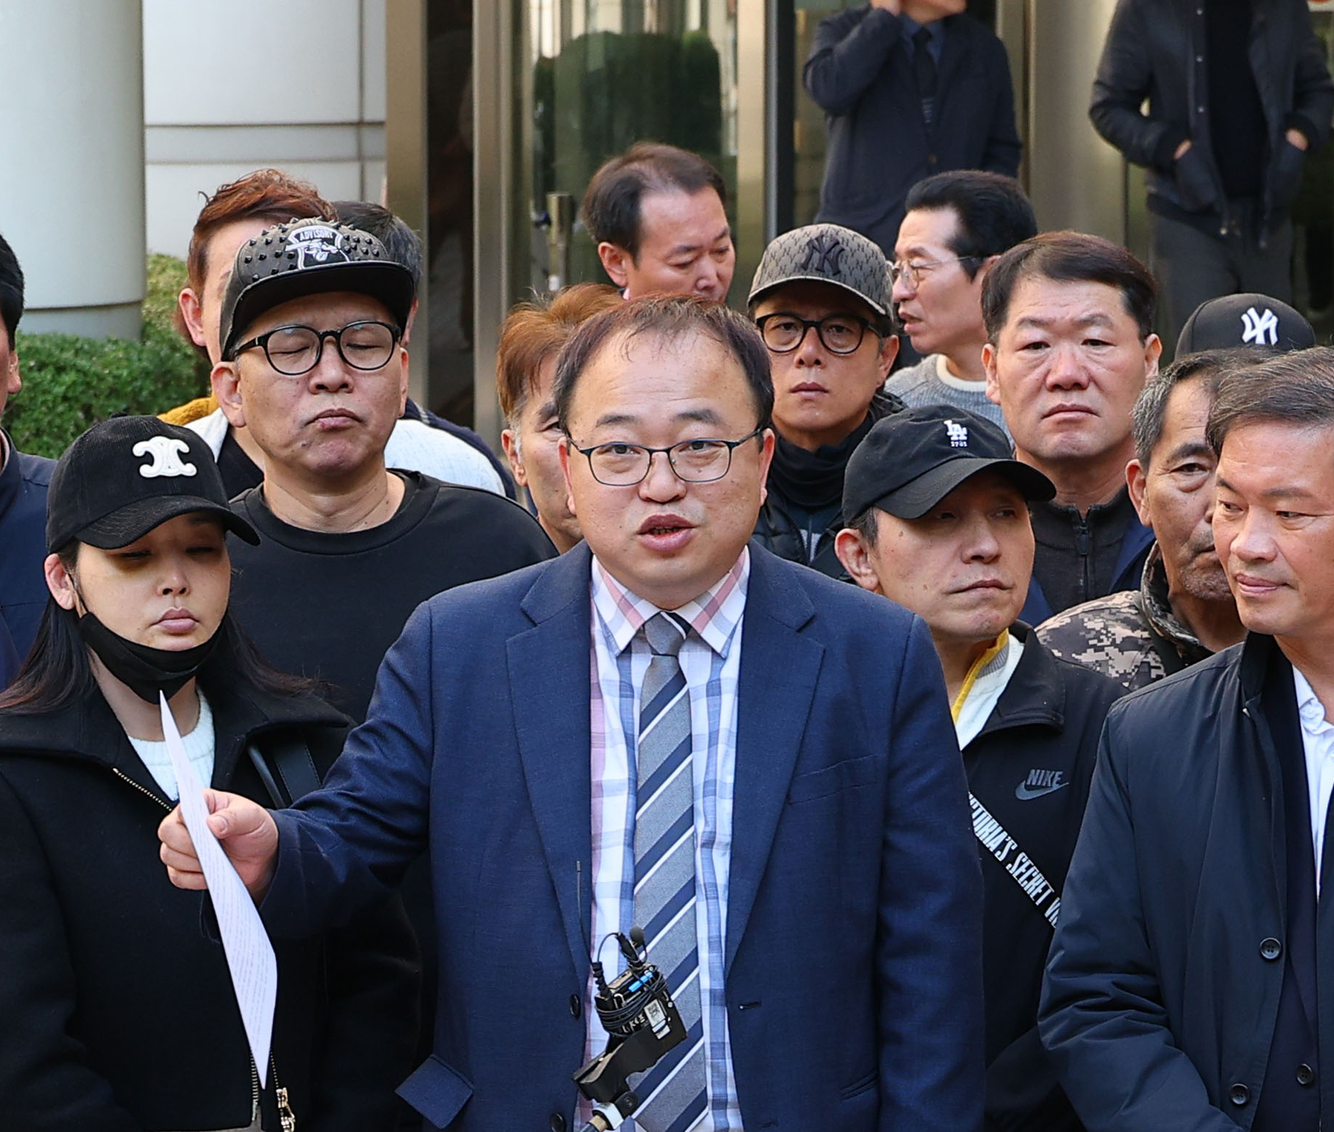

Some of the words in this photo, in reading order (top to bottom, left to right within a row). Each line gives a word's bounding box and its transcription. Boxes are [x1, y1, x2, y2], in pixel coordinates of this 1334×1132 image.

[801, 234, 845, 276] NY
[1241, 307, 1278, 346] NY
[944, 420, 968, 440] LA
[1026, 769, 1064, 787] NIKE
[1005, 852, 1055, 906] SECRET
